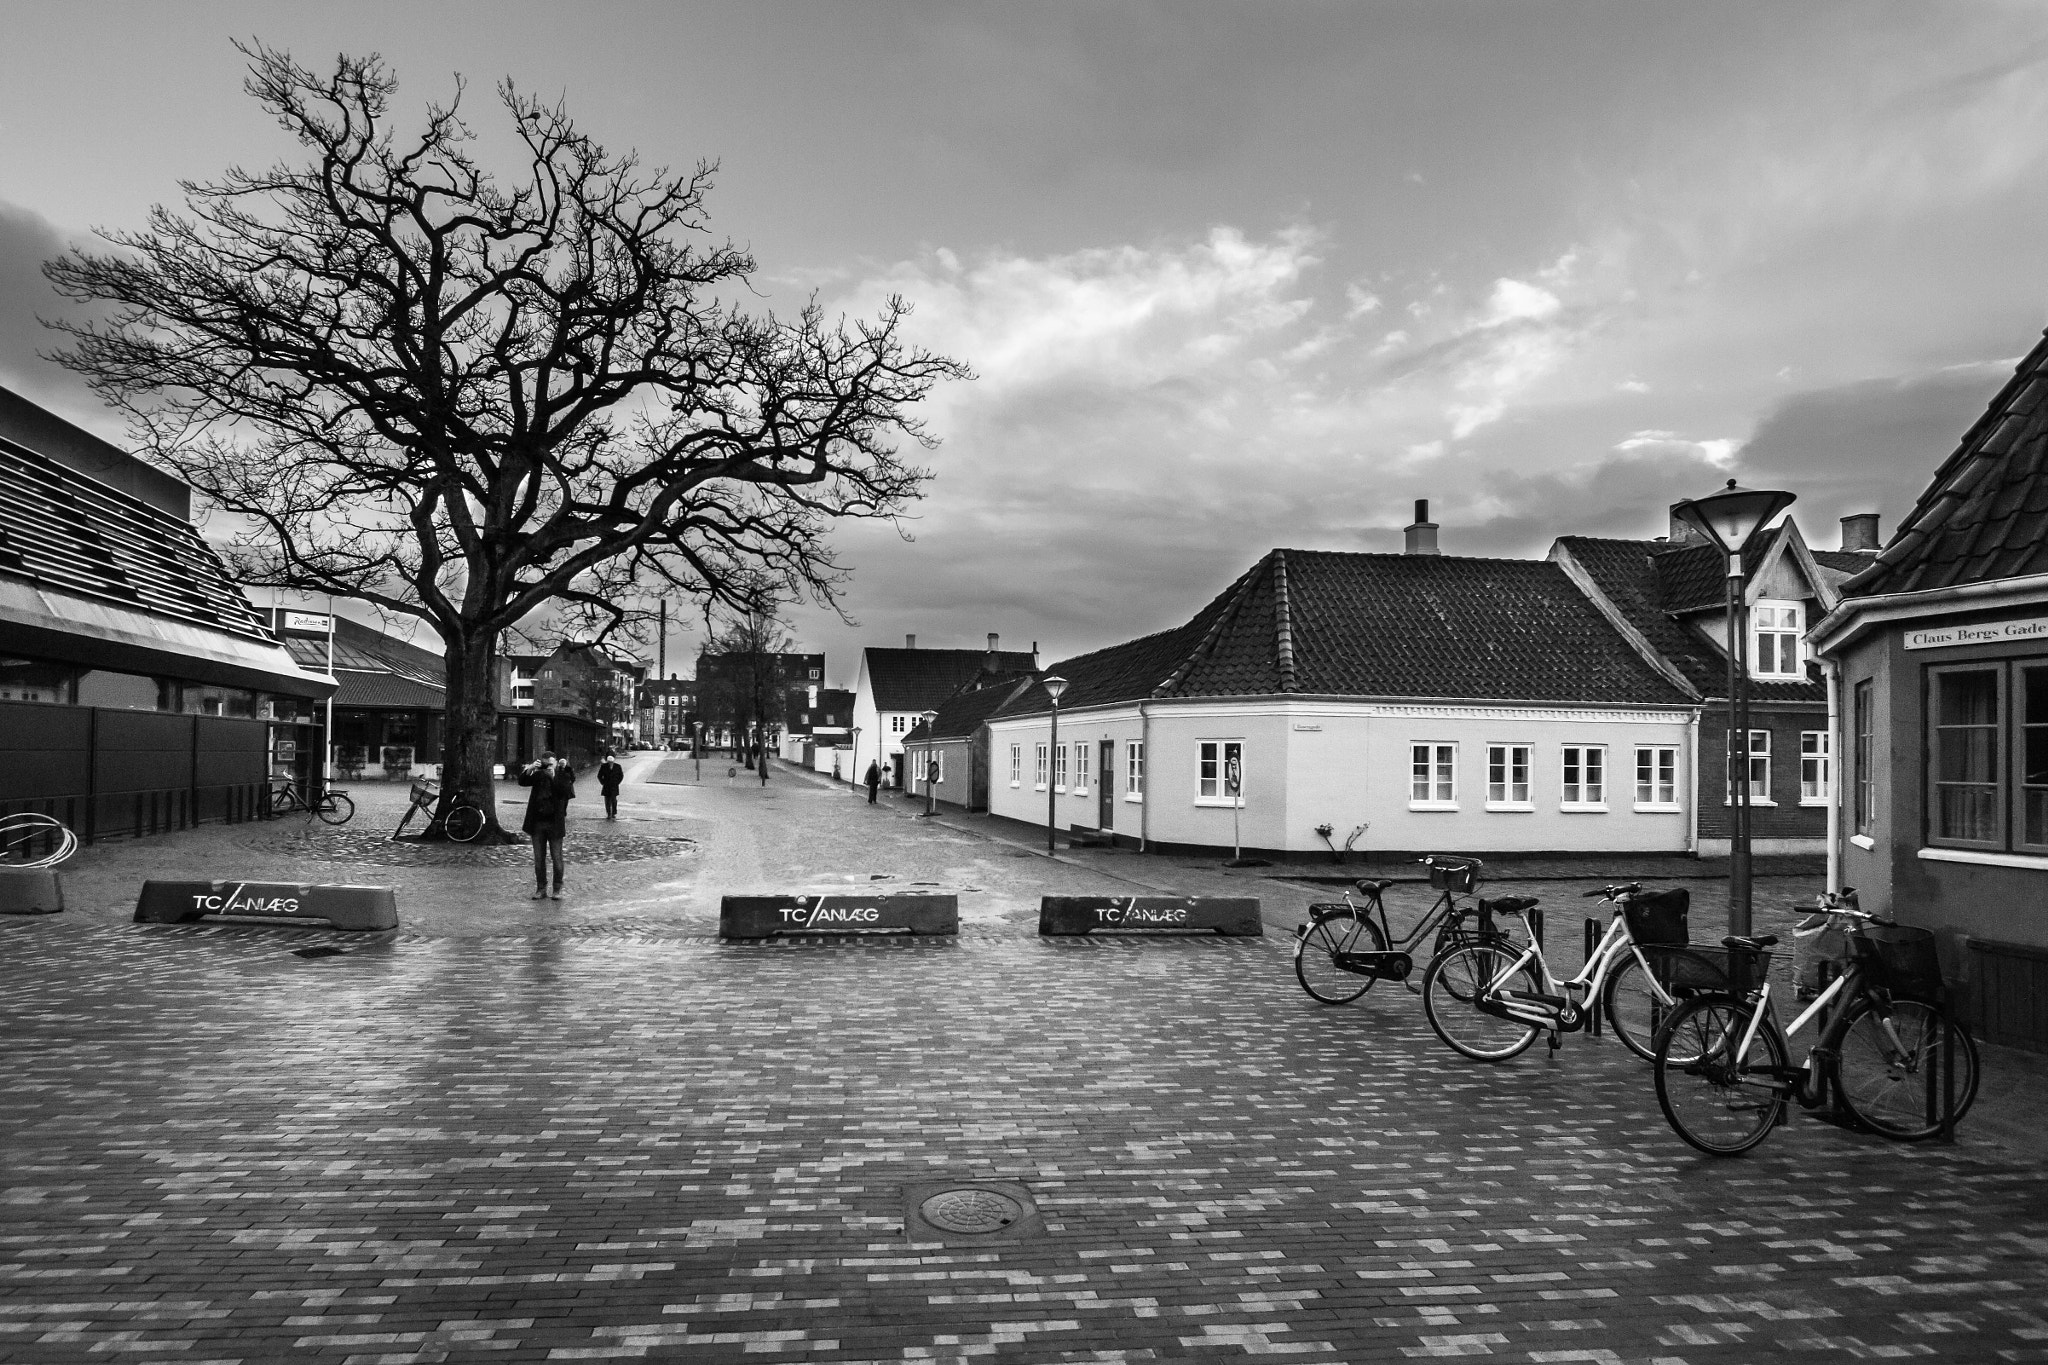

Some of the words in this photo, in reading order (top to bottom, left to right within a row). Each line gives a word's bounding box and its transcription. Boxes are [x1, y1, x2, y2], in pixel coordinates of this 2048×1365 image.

[1913, 633, 1952, 645] Claus
[1958, 629, 1999, 640] Bergs
[2004, 623, 2047, 636] Gade
